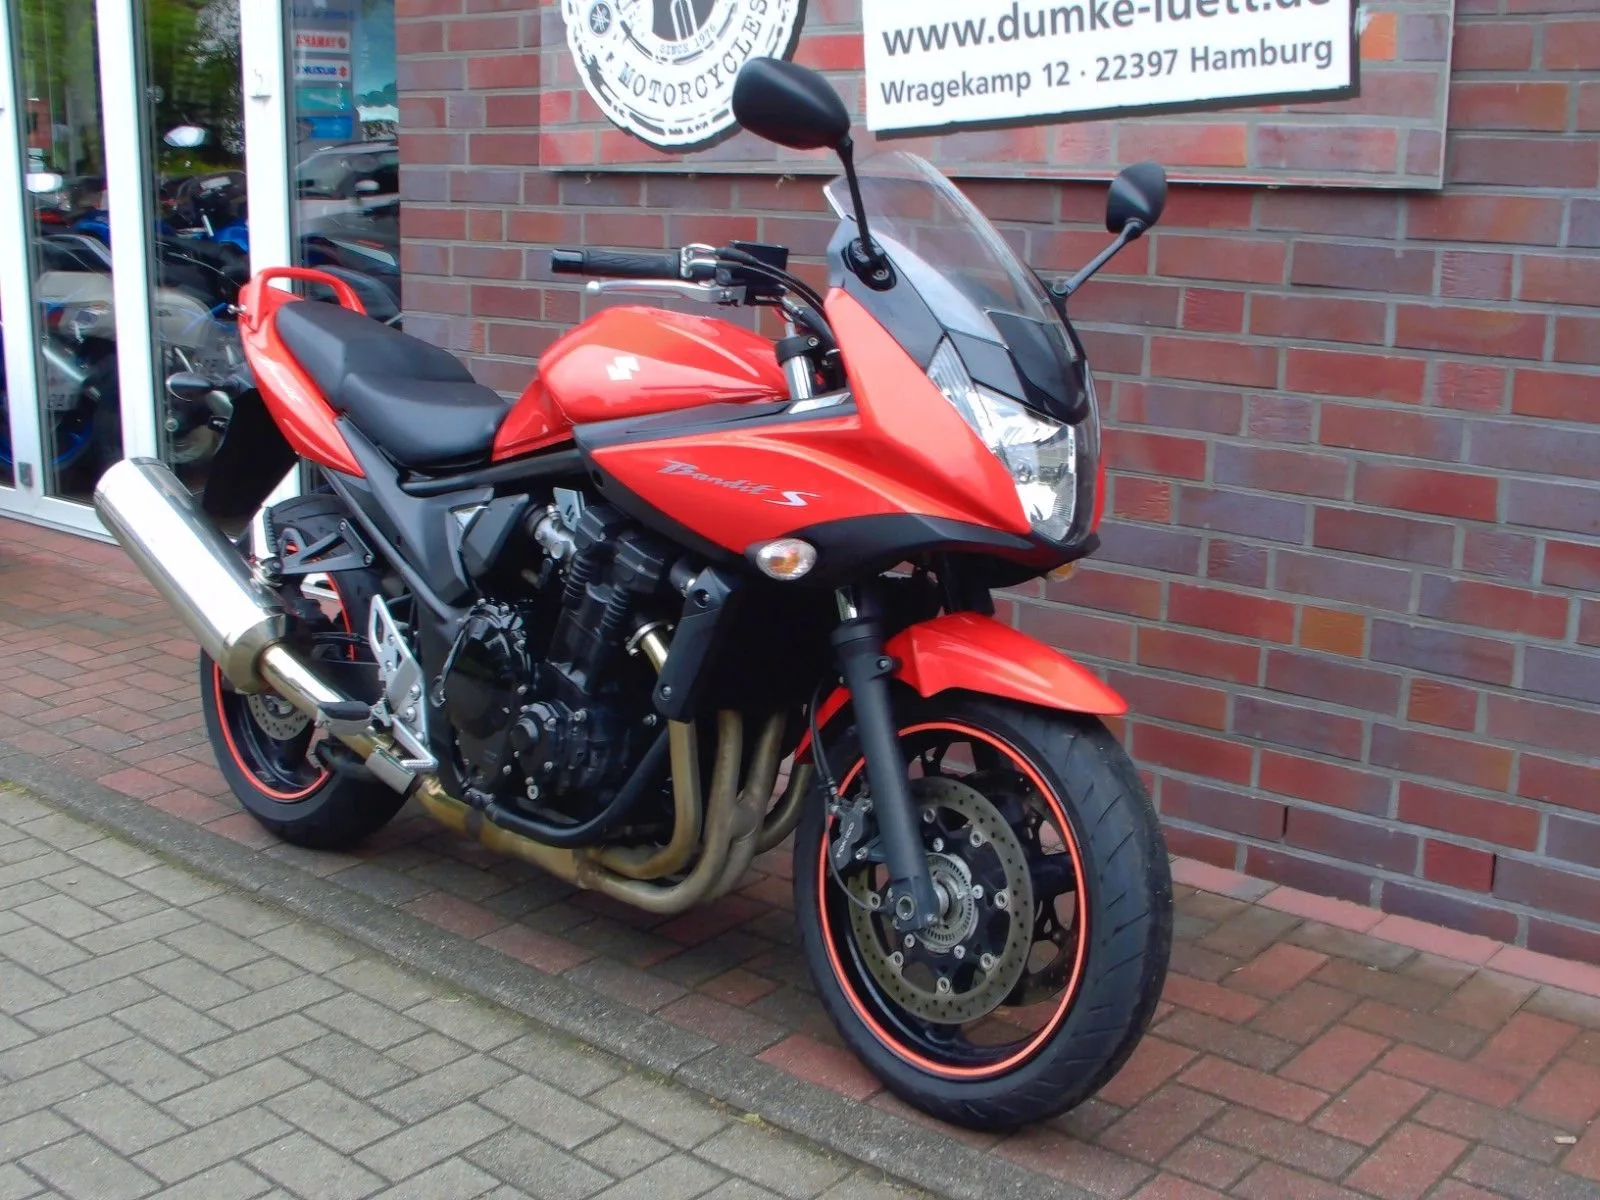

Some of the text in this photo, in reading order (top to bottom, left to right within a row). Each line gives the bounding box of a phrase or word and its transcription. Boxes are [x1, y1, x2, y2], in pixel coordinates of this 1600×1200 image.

[617, 0, 768, 107] MOTORCYCLES
[882, 0, 1331, 56] www.dumke-lue.
[881, 37, 1333, 107] Wragekamp 12 22397 Hamburg
[656, 458, 777, 495] Bandit
